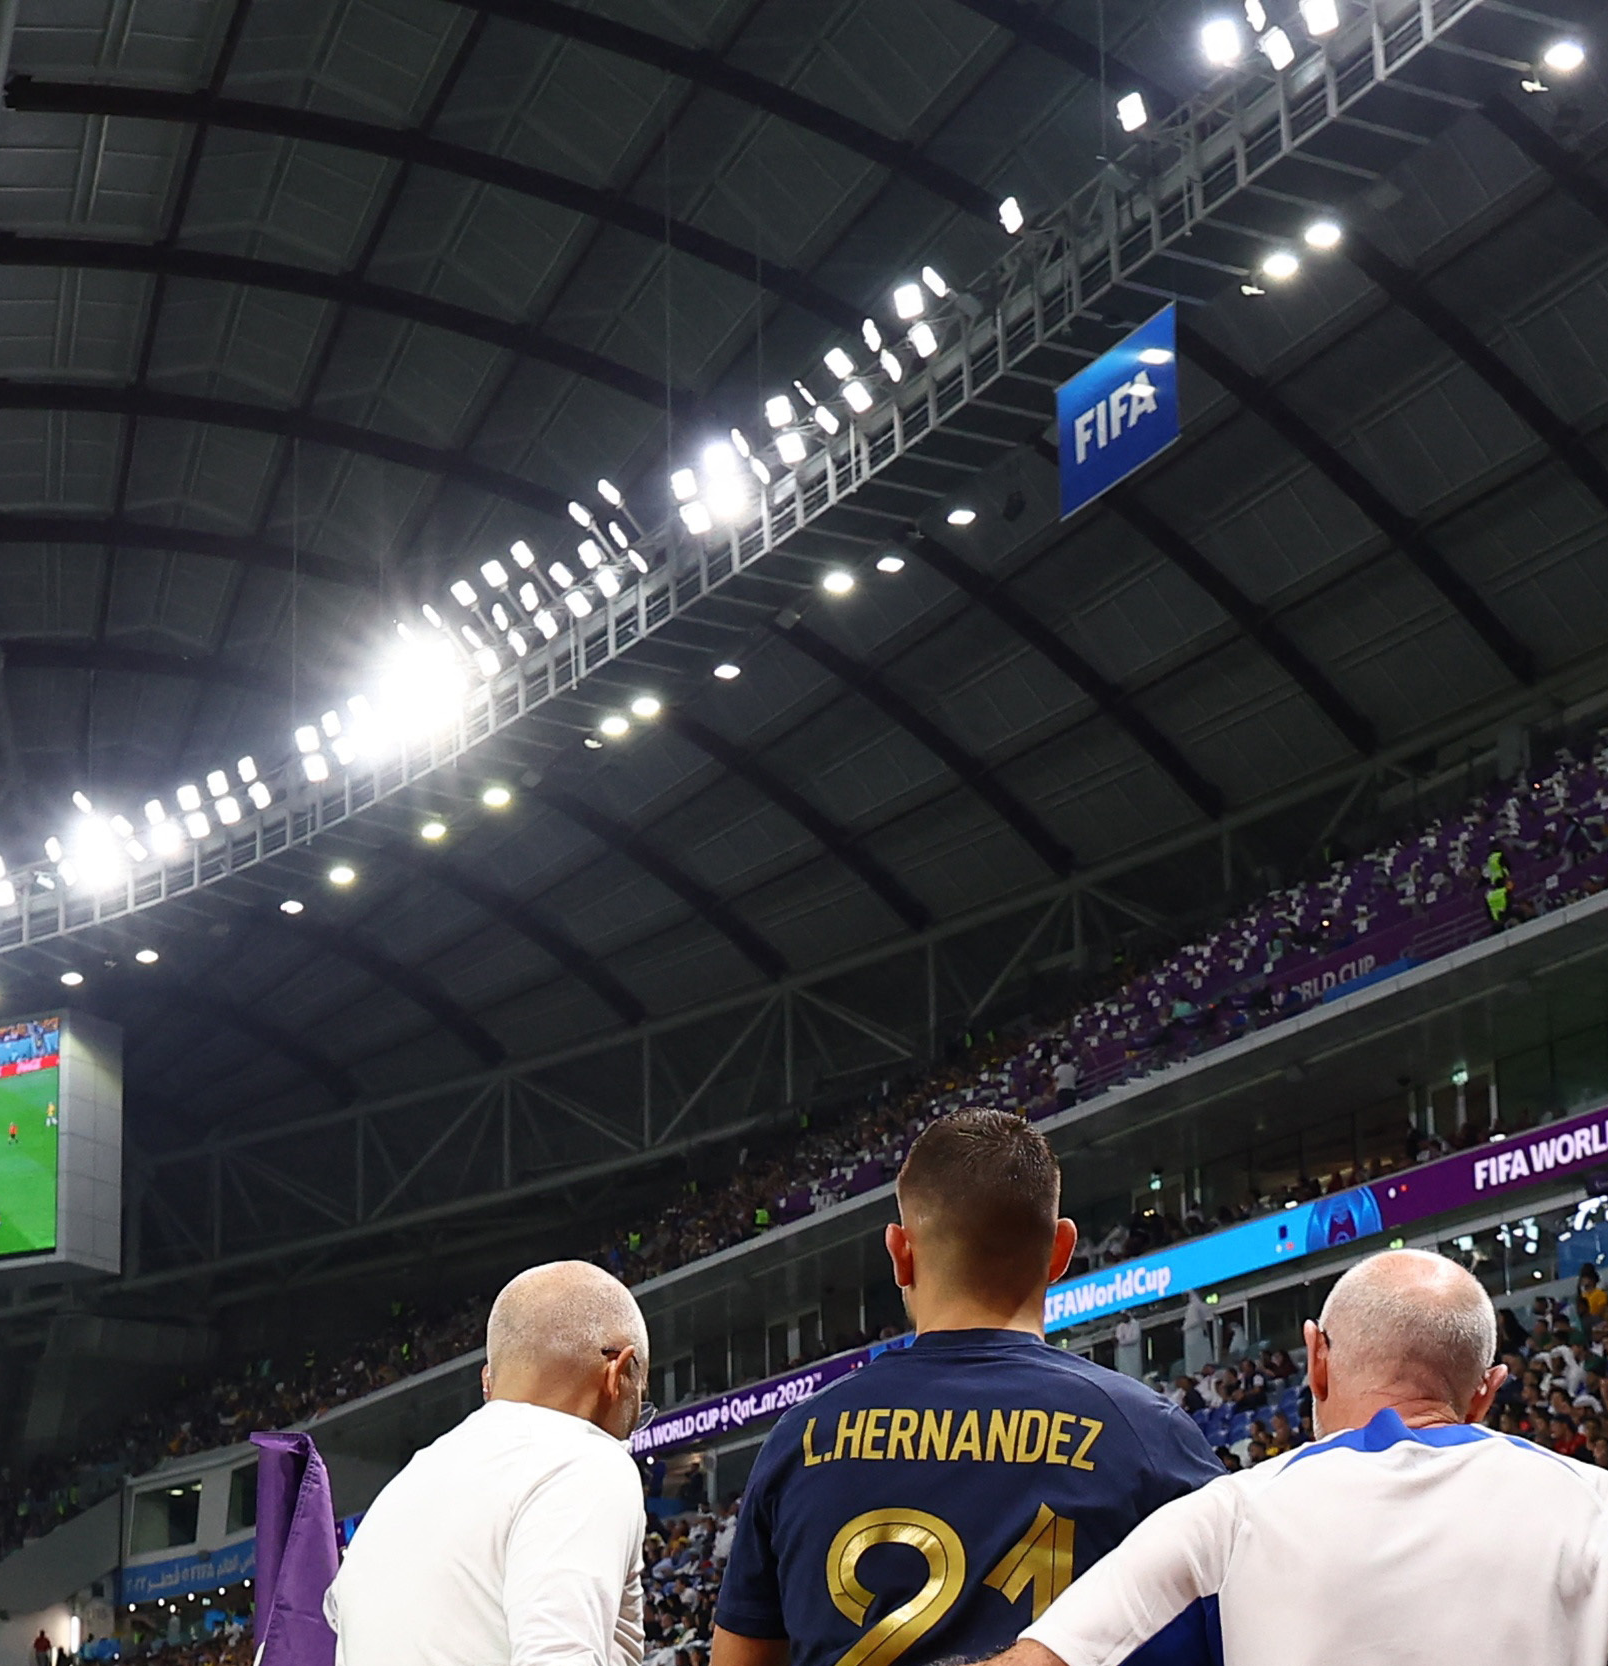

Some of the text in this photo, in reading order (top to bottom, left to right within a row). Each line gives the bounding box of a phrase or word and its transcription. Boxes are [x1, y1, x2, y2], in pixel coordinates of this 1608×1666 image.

[1073, 369, 1158, 465] FIFA
[1473, 1153, 1530, 1190] FIFA
[652, 1416, 694, 1447] WORLD
[695, 1407, 722, 1434] CUP
[802, 1407, 1104, 1471] L.HERNANDEZ
